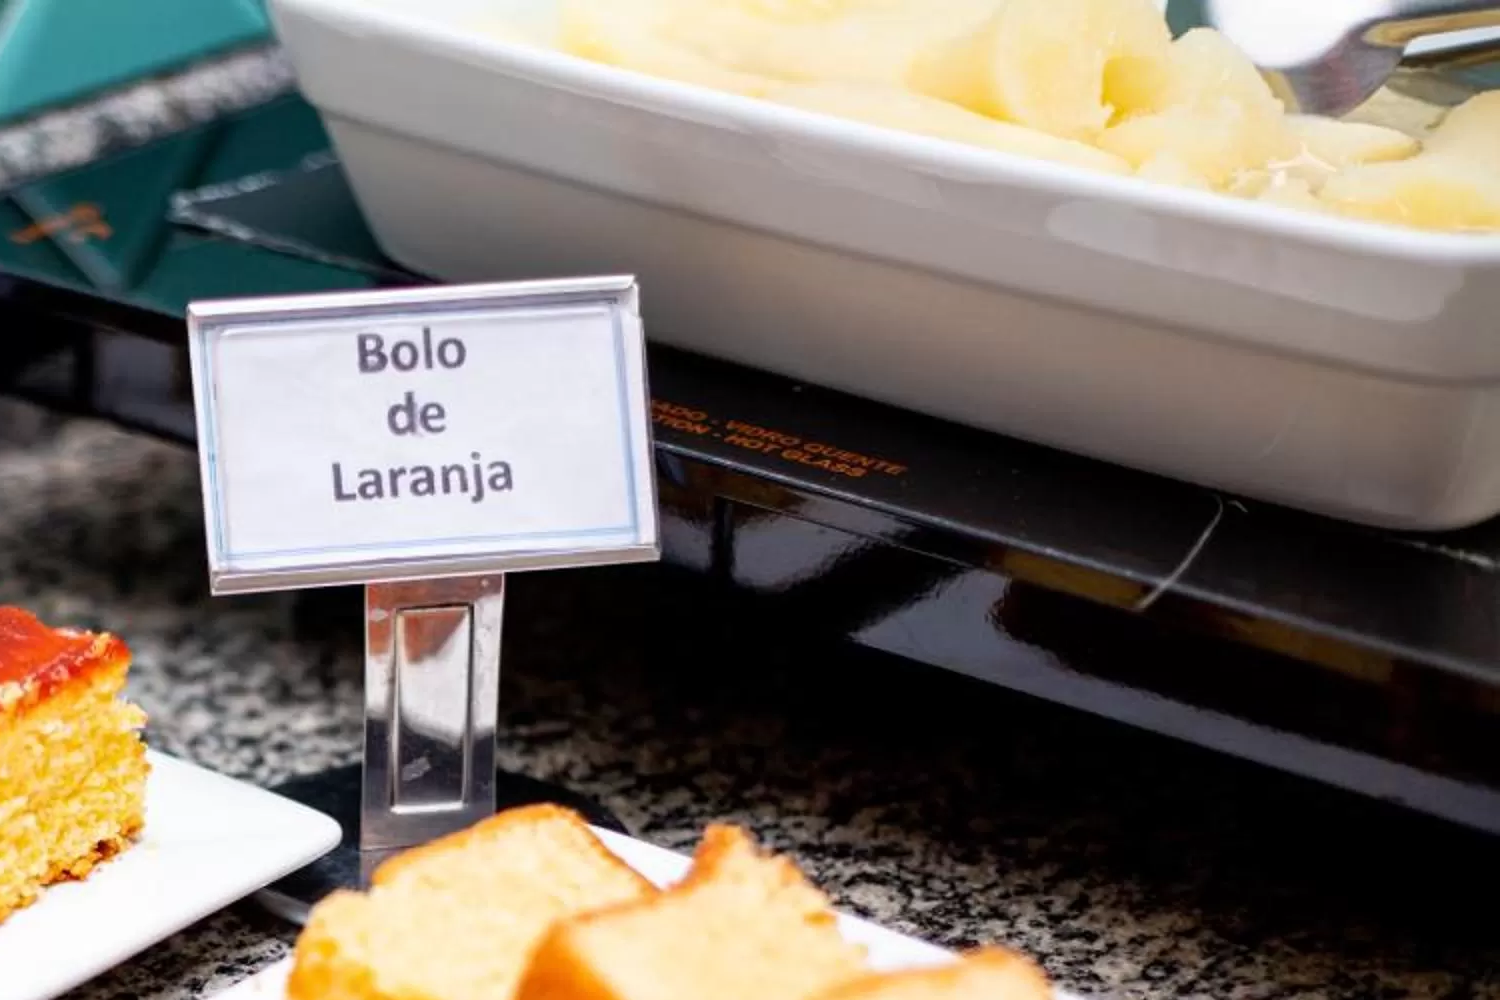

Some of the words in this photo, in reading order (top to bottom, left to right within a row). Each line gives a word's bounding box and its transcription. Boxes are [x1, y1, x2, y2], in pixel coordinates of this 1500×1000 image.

[357, 326, 467, 374] Bolo
[387, 391, 447, 436] de
[723, 434, 780, 453] HOT
[332, 452, 514, 503] Laranja
